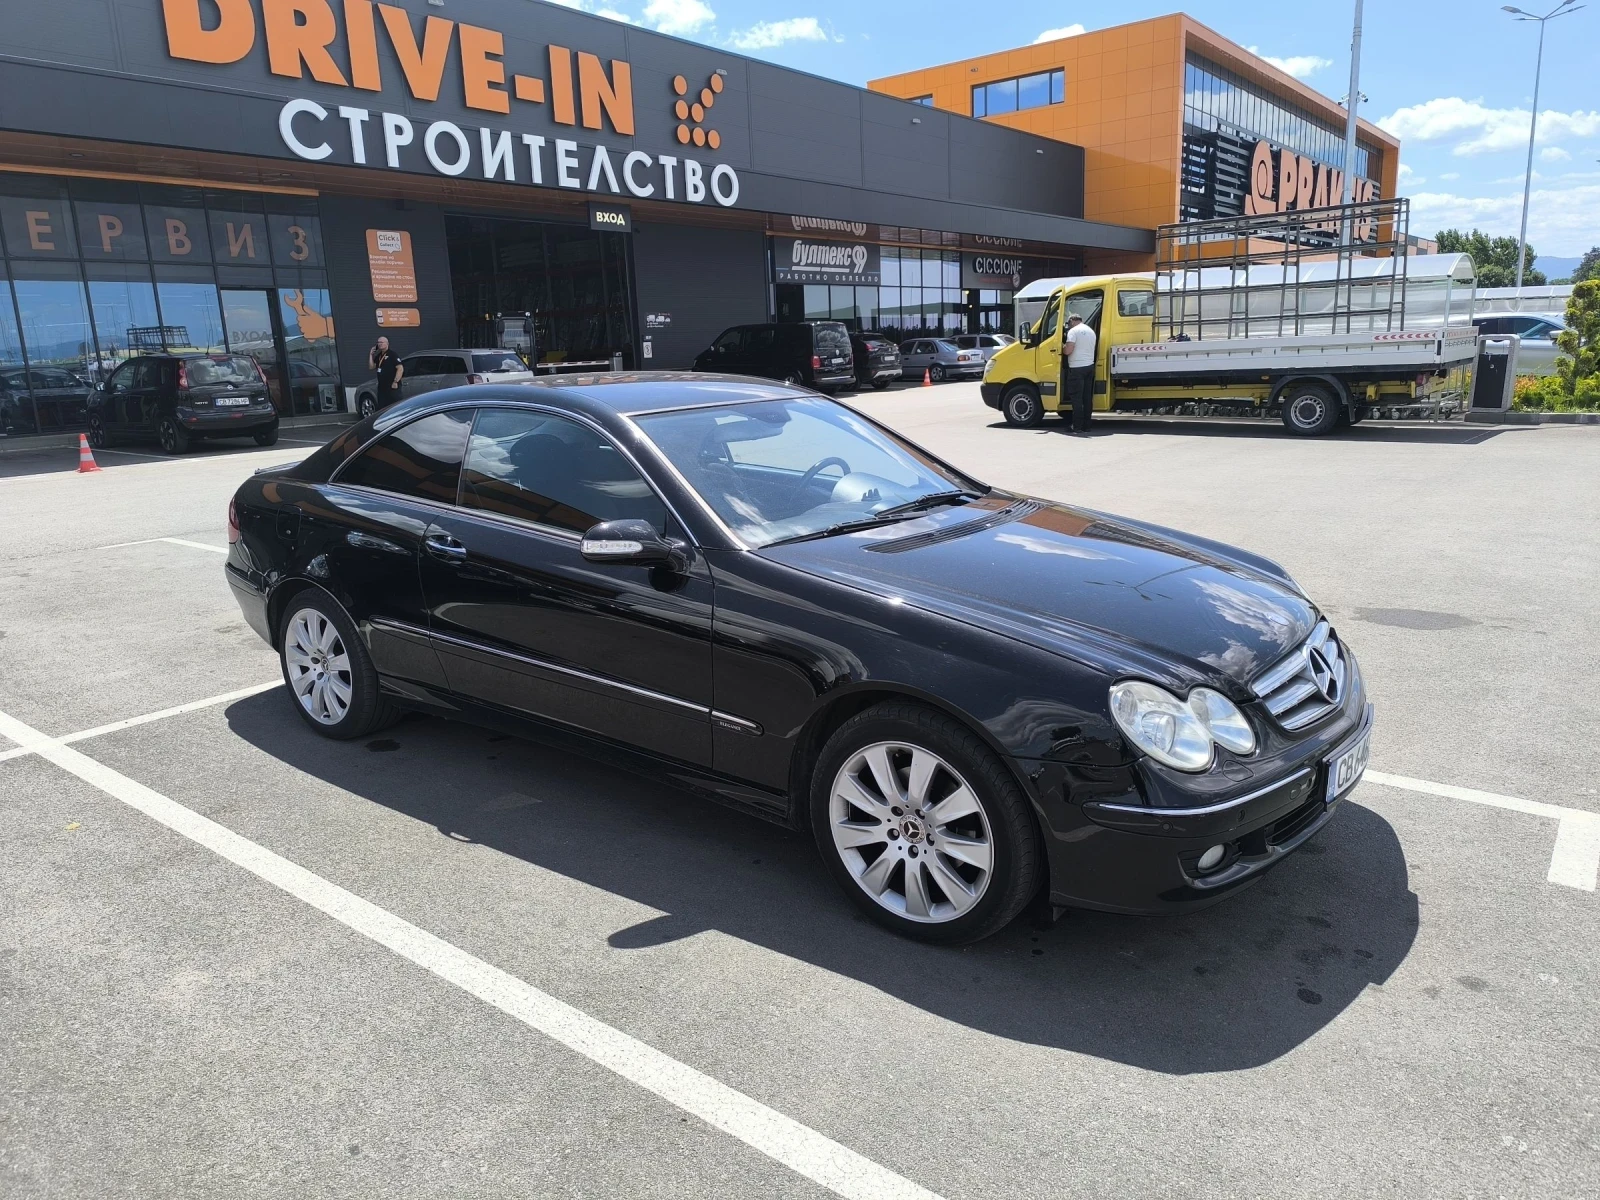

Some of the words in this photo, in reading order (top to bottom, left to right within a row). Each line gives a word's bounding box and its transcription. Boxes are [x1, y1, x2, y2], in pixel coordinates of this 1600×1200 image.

[162, 0, 635, 135] DRIVE-IN
[279, 98, 740, 207] СТРОИТЕЛСТВО
[596, 211, 626, 226] ВХОД
[378, 234, 396, 242] Click
[975, 257, 1022, 275] CICCIONE
[779, 273, 828, 281] РАБОТНО
